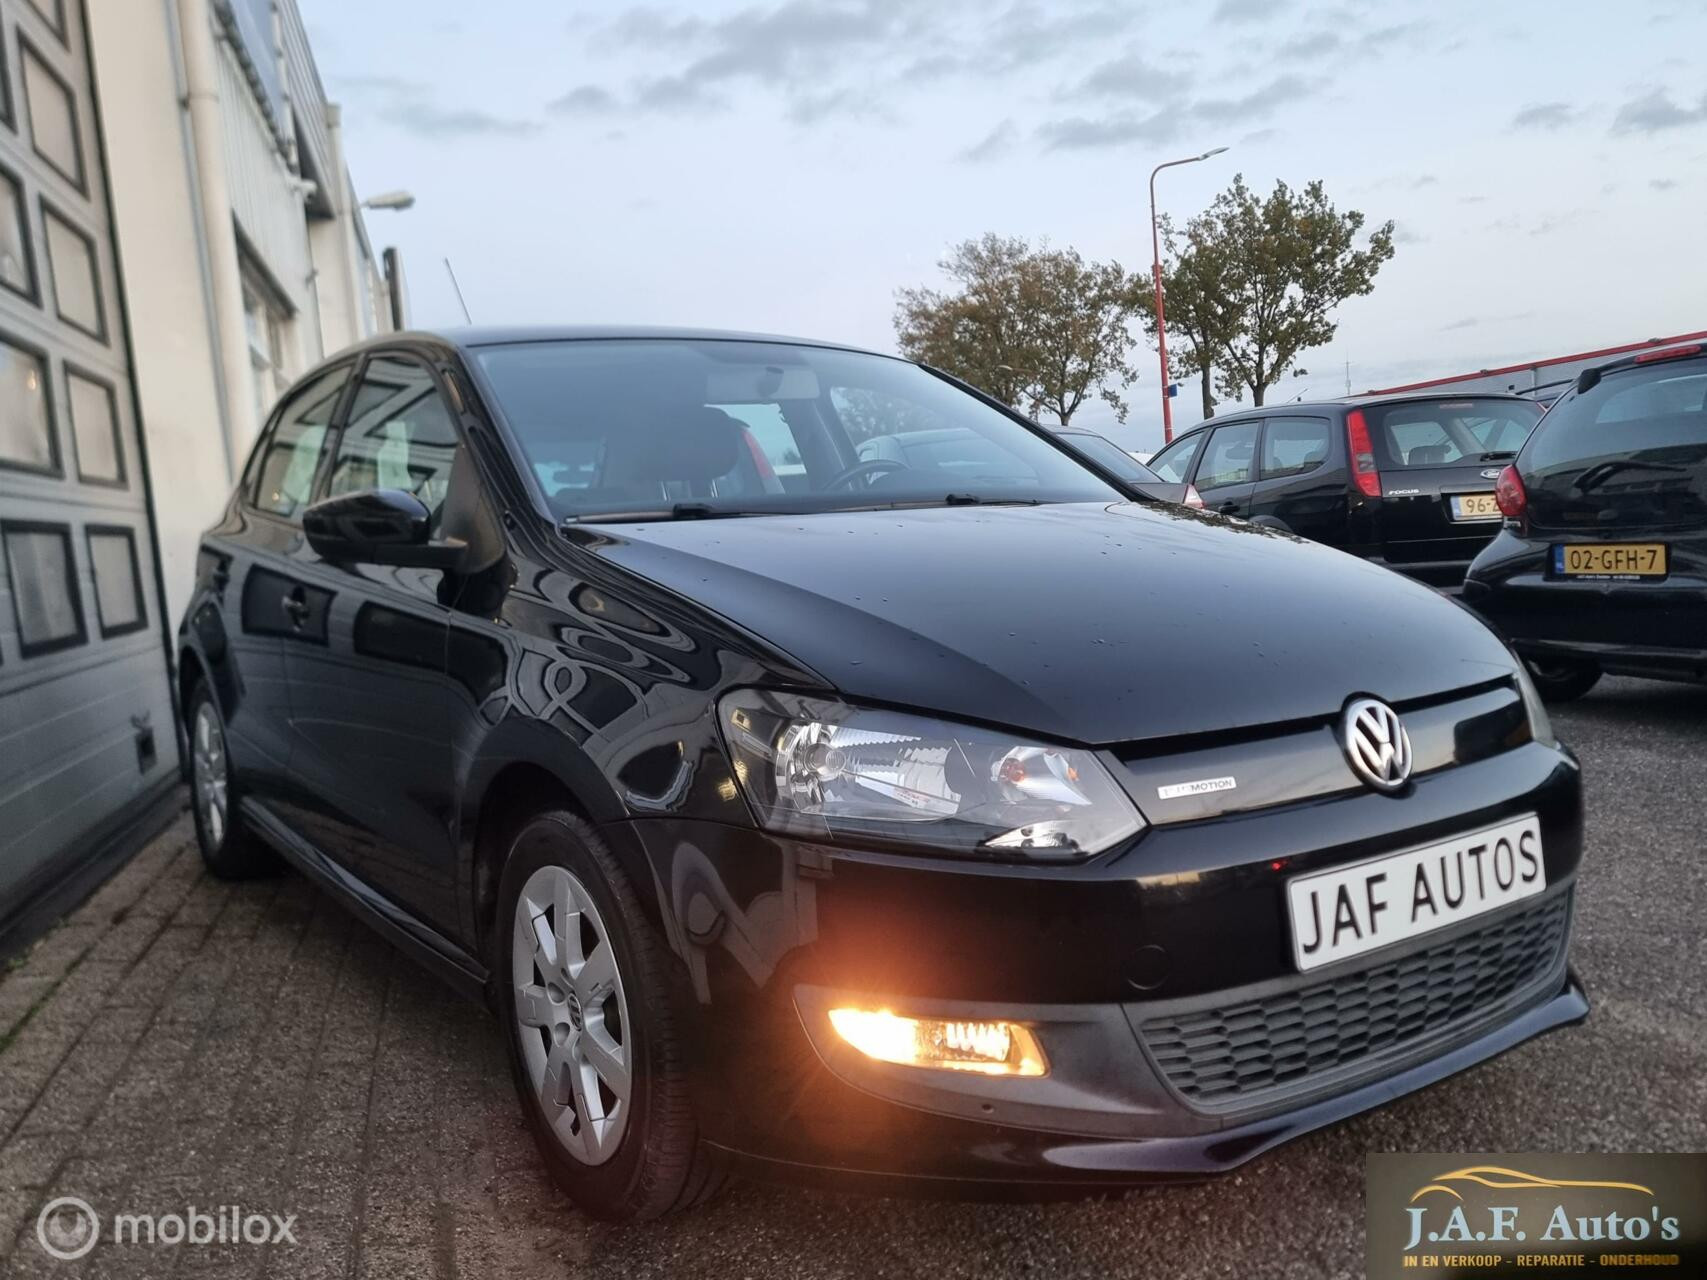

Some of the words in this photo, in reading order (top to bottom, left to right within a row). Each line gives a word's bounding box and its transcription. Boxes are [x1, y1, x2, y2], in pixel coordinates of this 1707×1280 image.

[1570, 549, 1658, 570] 02-GFH-7
[1163, 778, 1233, 797] MOTION
[1303, 873, 1387, 953] JAF
[1411, 830, 1537, 922] AUTOS
